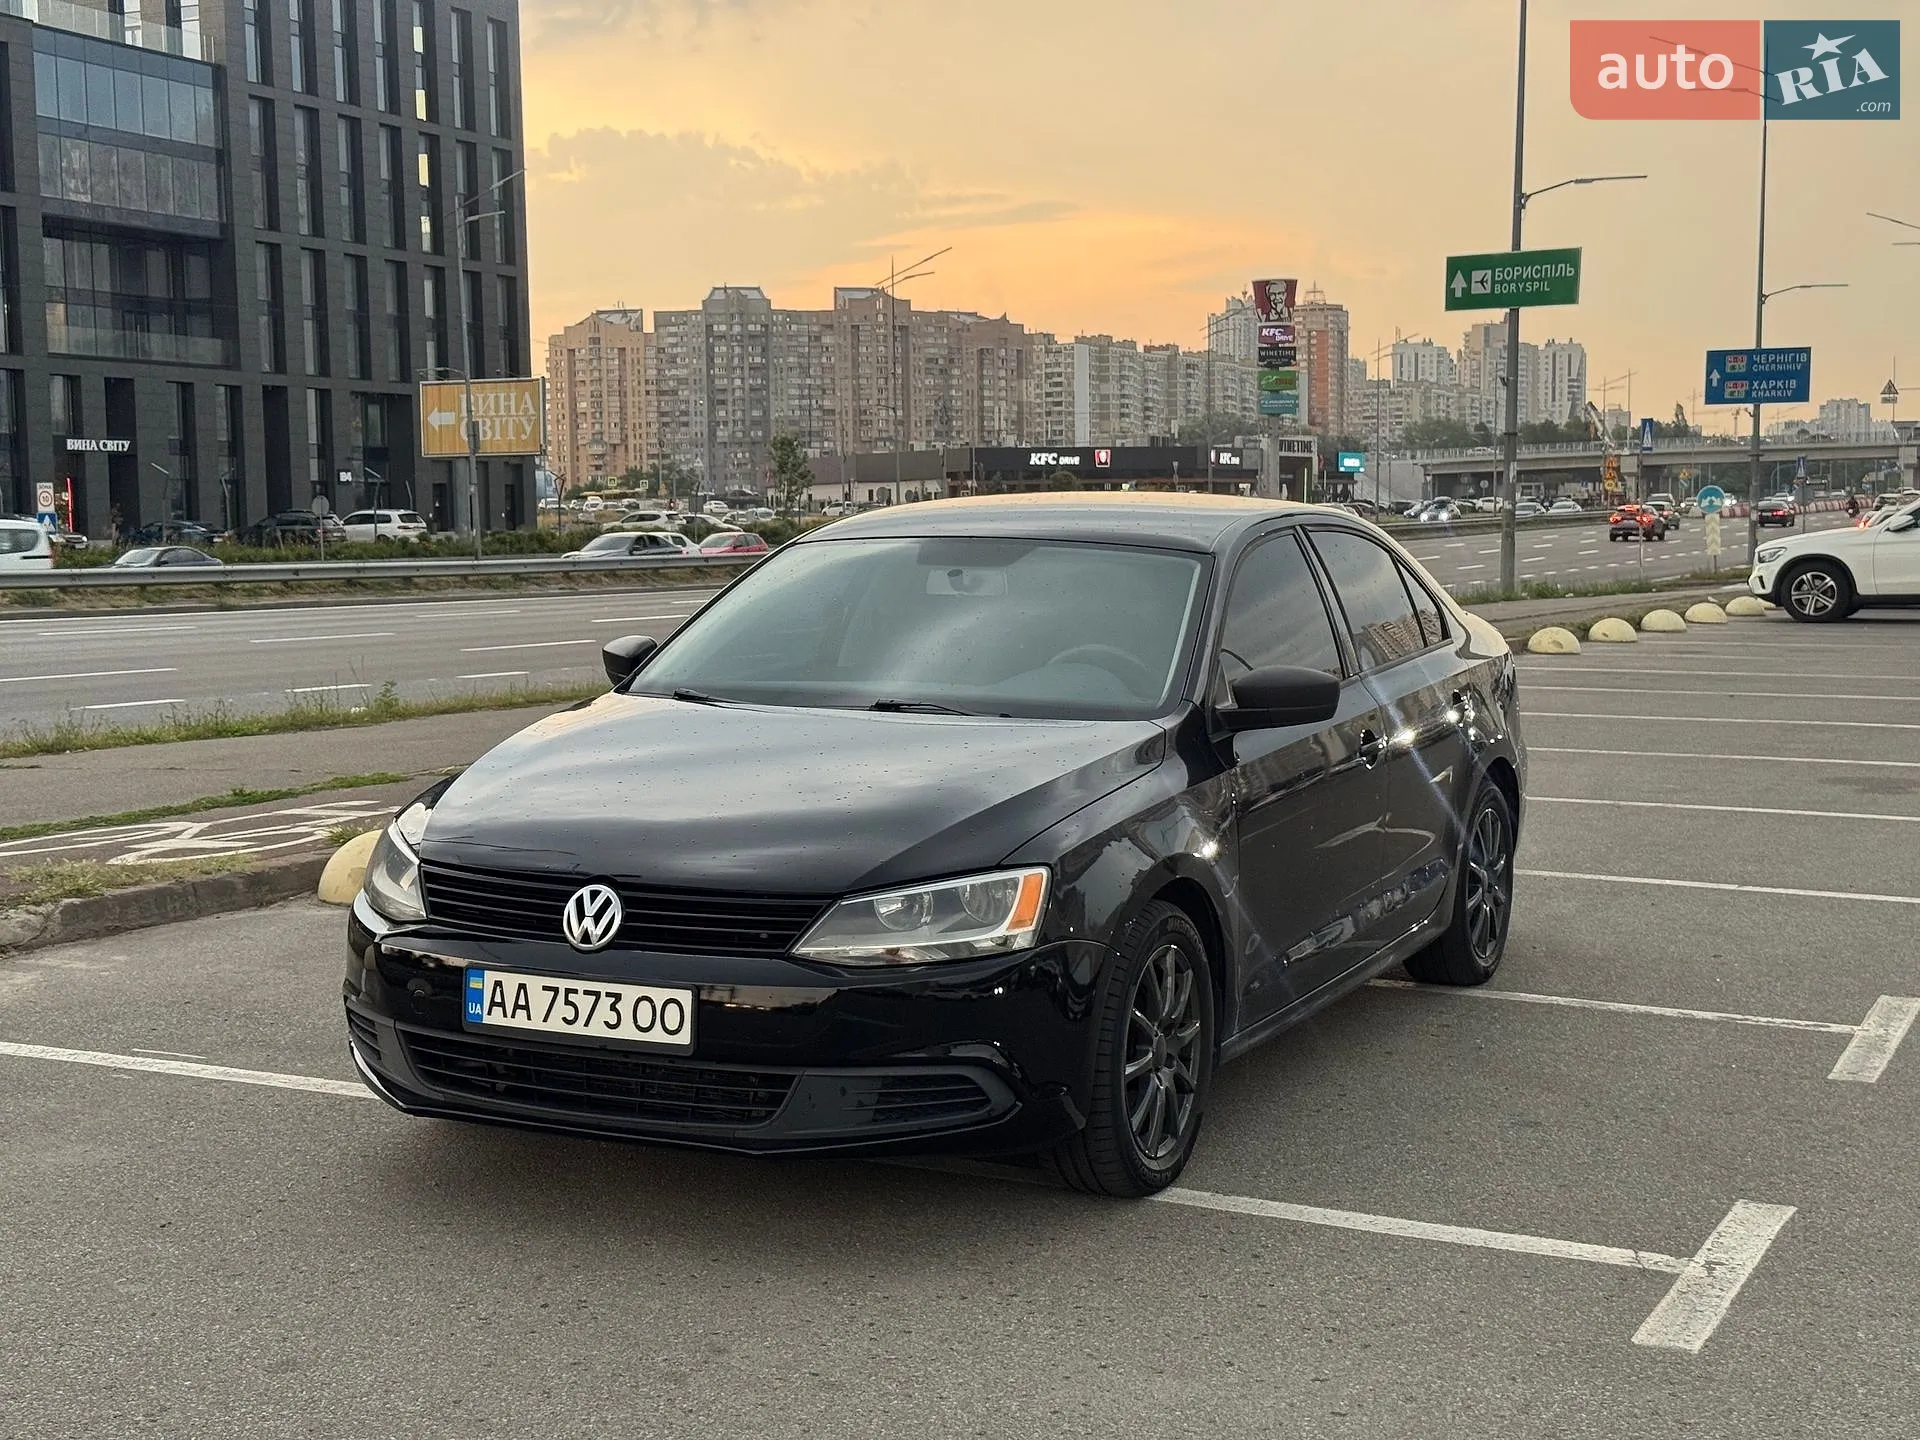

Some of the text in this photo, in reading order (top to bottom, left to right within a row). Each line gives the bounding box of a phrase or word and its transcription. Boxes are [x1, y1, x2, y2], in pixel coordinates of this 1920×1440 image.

[1495, 263, 1575, 281] БОРИСПІЛЬ
[1494, 281, 1550, 294] BORYSPIL
[1262, 328, 1284, 336] KFC
[1752, 352, 1807, 364] ЧЕРНІГІВ
[1752, 363, 1802, 372] CHERNIHIV
[1752, 379, 1797, 390] ХАРКІВ
[1751, 390, 1793, 398] KHARKIV
[66, 439, 131, 452] ВИНА СВІТУ
[1029, 452, 1080, 465] KFC DRIVE
[468, 1001, 482, 1016] UA
[486, 979, 532, 1021] AA
[541, 984, 622, 1030] 7573
